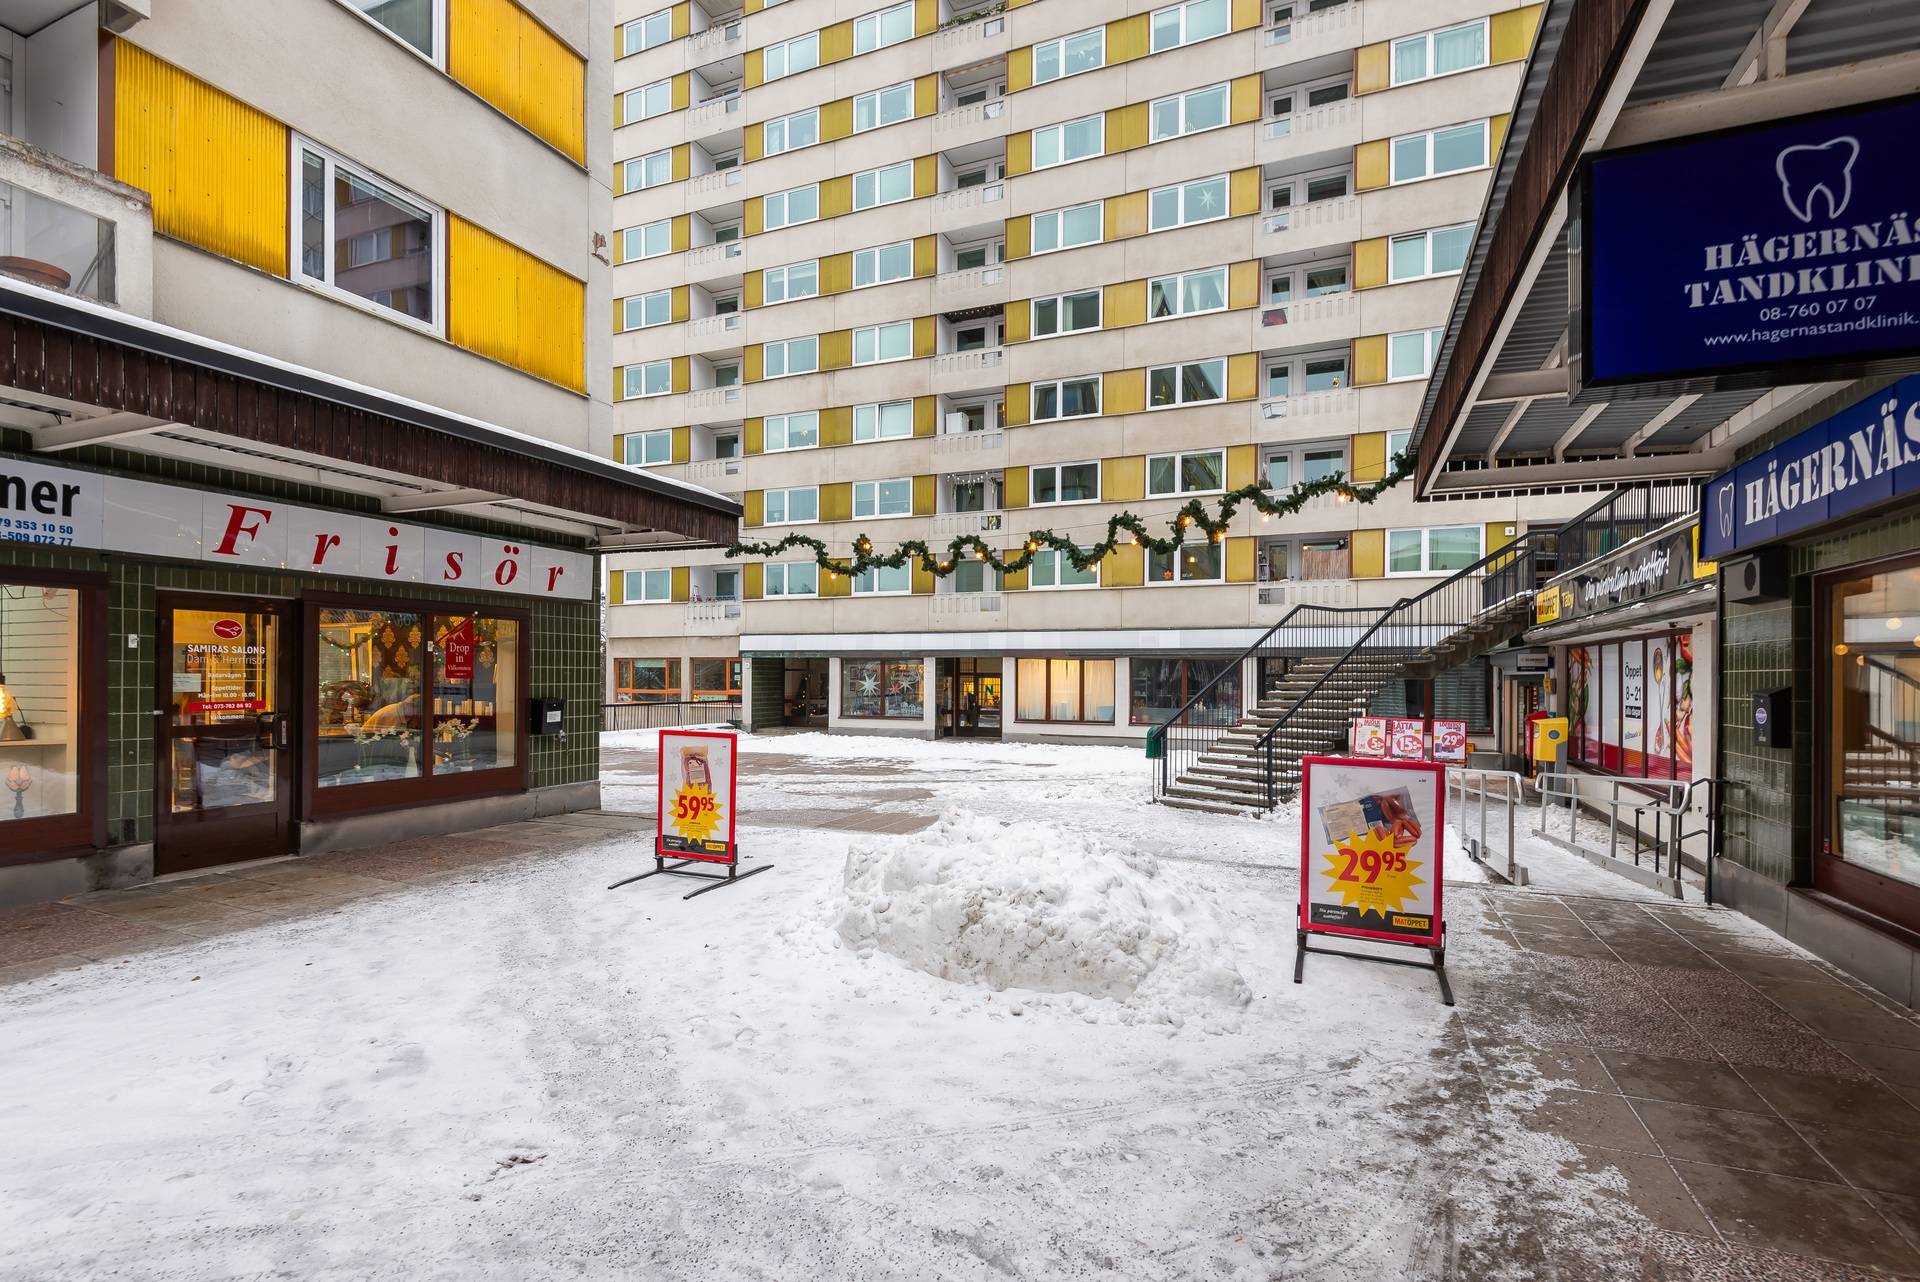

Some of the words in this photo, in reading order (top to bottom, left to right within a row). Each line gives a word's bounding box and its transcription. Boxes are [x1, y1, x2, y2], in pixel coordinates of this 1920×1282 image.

[1760, 301, 1819, 322] 08-760
[1826, 298, 1848, 314] 07
[1854, 295, 1877, 311] 07
[15, 520, 37, 531] 353
[42, 523, 55, 533] 10
[59, 525, 73, 535] 50
[34, 534, 55, 545] 072
[59, 537, 73, 546] 77
[212, 503, 564, 592] Frisör
[187, 644, 229, 653] SAMIRAS
[231, 645, 266, 654] SALONG
[450, 642, 470, 655] Drop
[455, 652, 464, 663] in
[1625, 662, 1642, 679] Öppet
[1625, 686, 1630, 700] 8
[1634, 686, 1642, 701] 21
